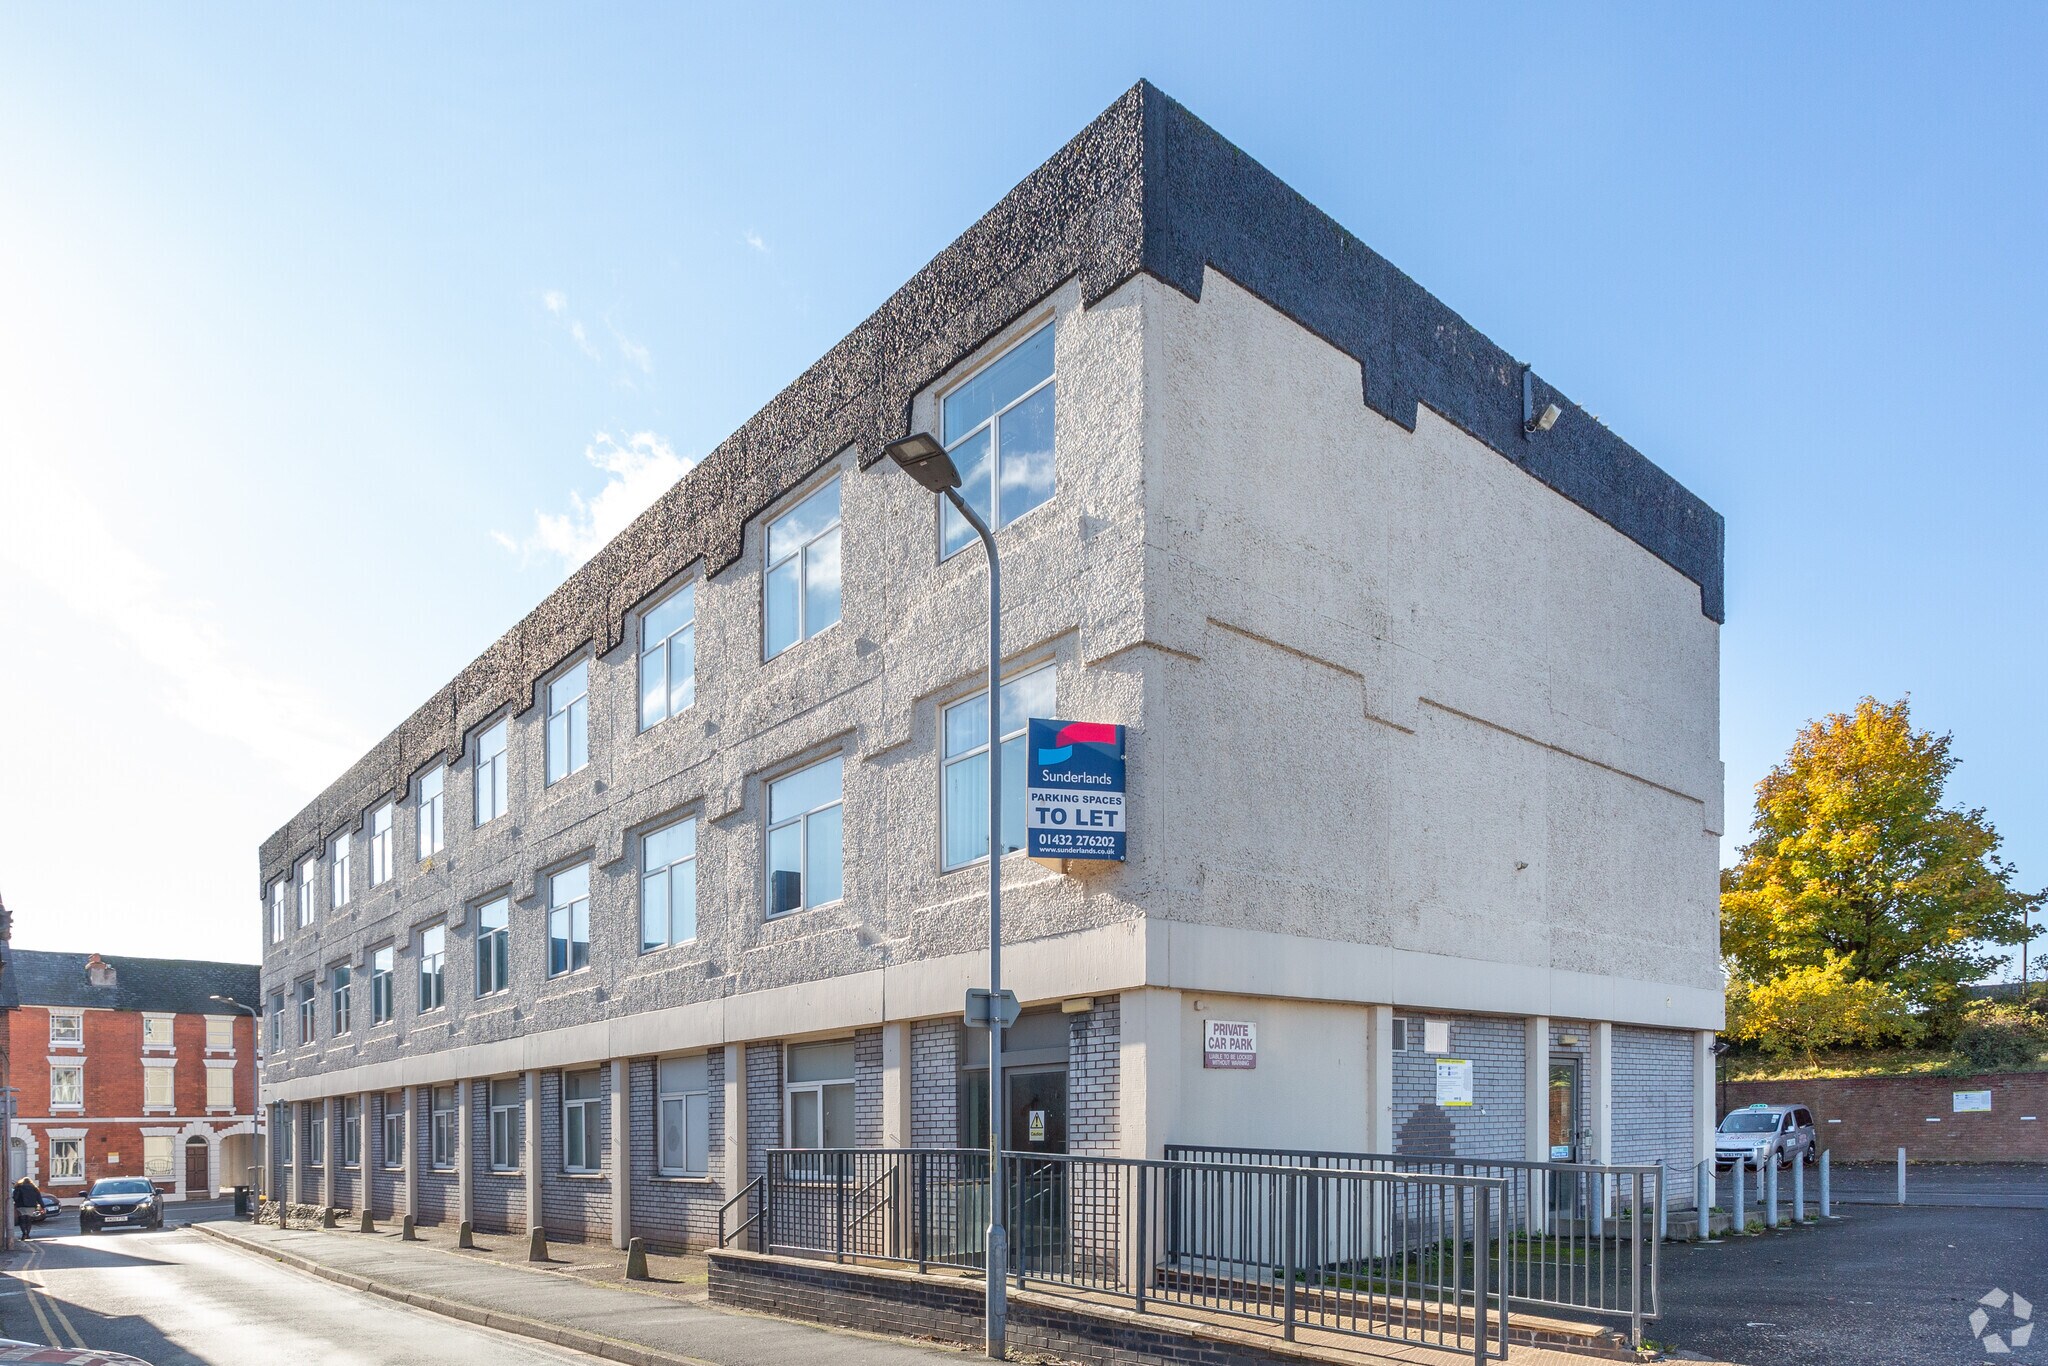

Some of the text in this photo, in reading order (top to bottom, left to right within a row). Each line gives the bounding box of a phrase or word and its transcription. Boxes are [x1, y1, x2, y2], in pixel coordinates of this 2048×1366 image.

[1042, 769, 1111, 784] Sunderlands
[1031, 793, 1122, 805] PARKING SPACES
[1036, 807, 1118, 827] TO LET
[1039, 833, 1115, 847] 01432 276202
[1039, 847, 1115, 855] www.sunderlands.co.uk
[1213, 1023, 1248, 1036] PRIVATE
[1208, 1037, 1253, 1050] CAR PARK
